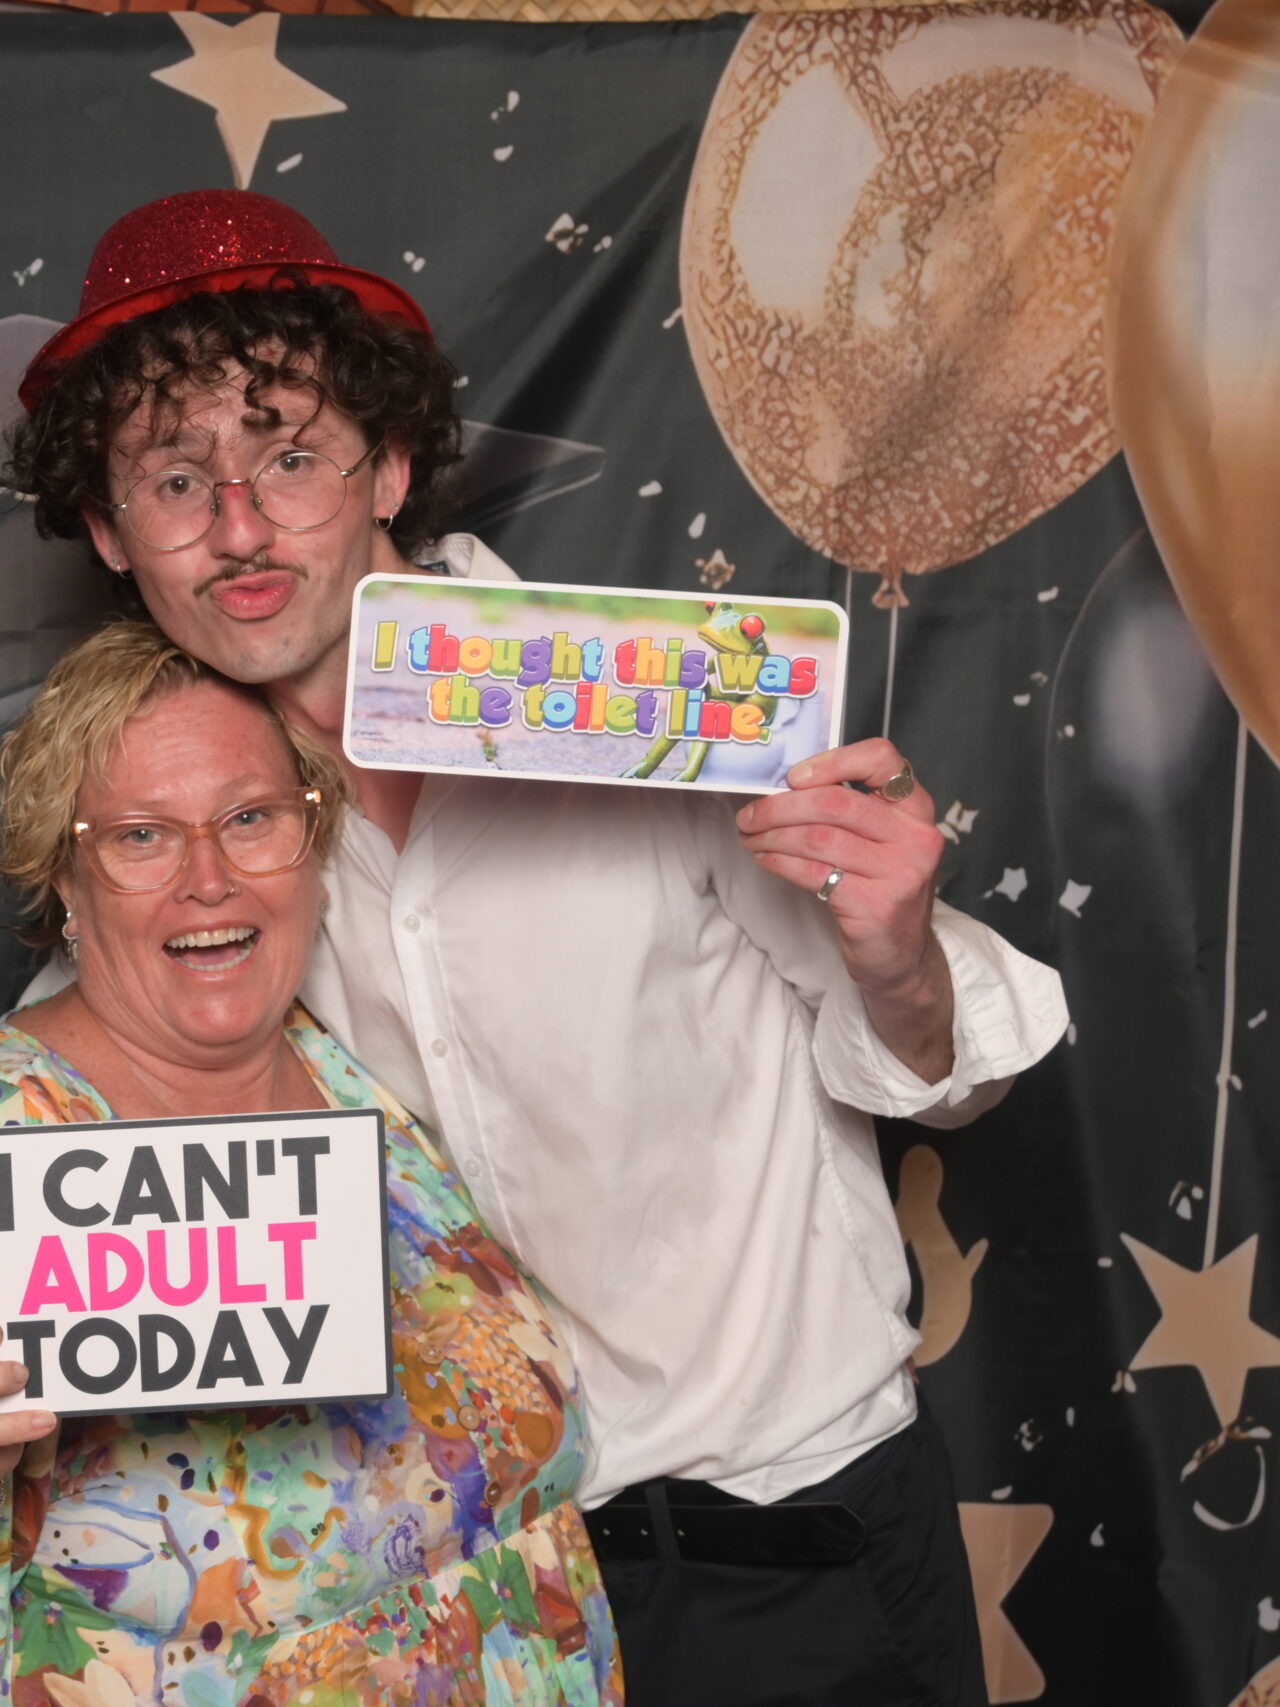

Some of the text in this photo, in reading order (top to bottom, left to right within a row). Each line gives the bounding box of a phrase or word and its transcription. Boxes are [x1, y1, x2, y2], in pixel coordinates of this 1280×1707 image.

[371, 620, 819, 697] I thought this was
[427, 674, 512, 727] the
[522, 680, 658, 737] toilet
[42, 1136, 330, 1228] CAN'T
[19, 1221, 317, 1315] ADULT
[7, 1304, 330, 1399] TODAY
